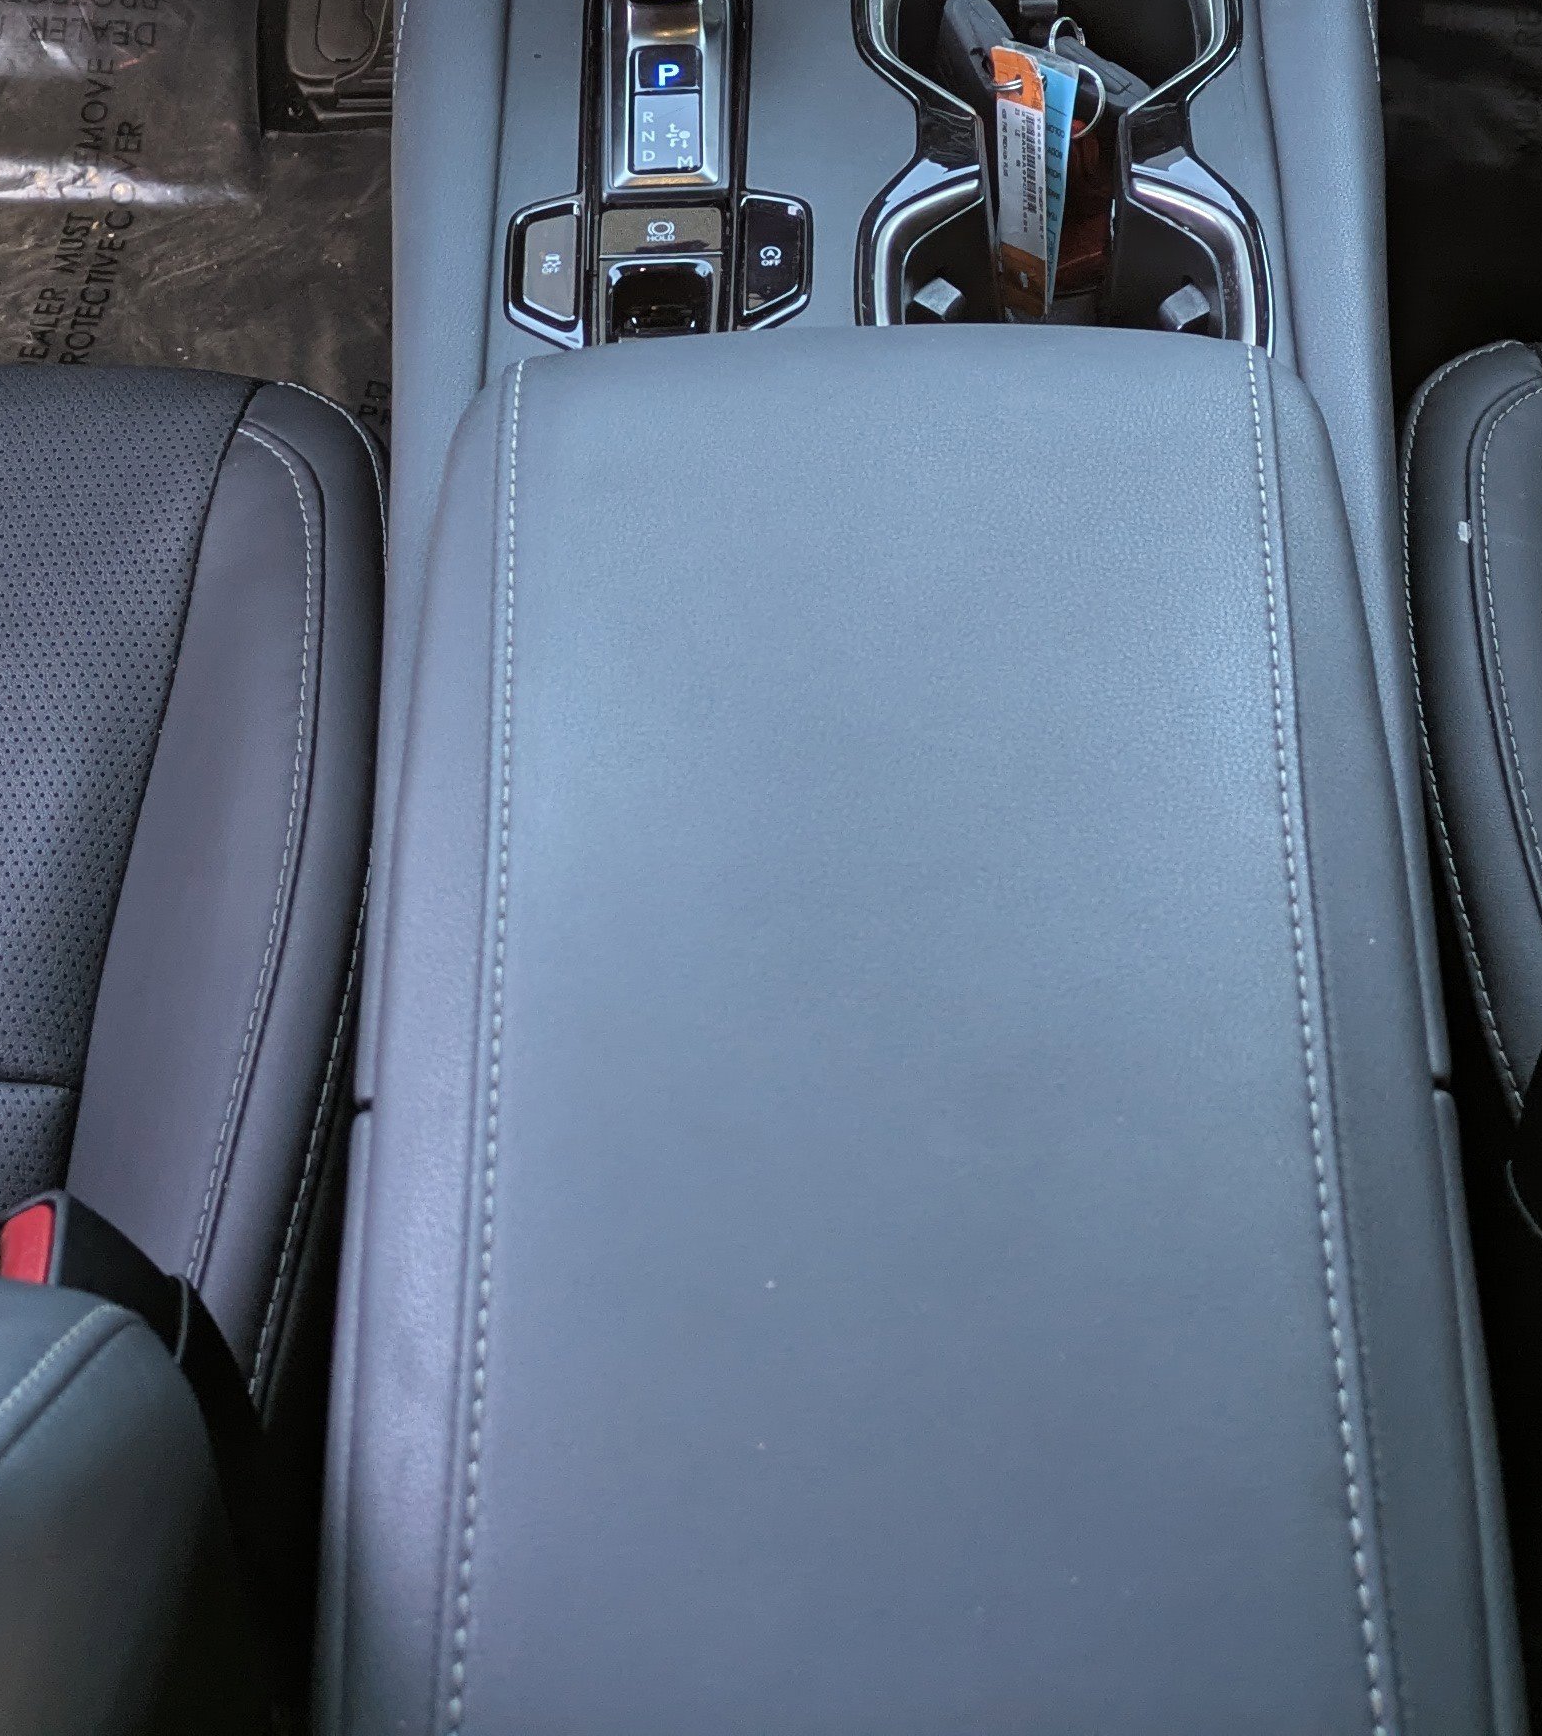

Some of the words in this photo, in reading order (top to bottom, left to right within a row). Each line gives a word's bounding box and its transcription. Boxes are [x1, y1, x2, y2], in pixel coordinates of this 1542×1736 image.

[29, 14, 157, 48] DEALER
[658, 63, 680, 86] P
[642, 111, 654, 123] R
[641, 130, 655, 142] N
[642, 150, 655, 162] D
[677, 155, 694, 169] M
[50, 212, 94, 274] MUST
[646, 234, 676, 242] HOLD
[761, 258, 781, 266] OFF
[541, 265, 560, 274] OFF
[59, 238, 126, 365] ROTECTIVE
